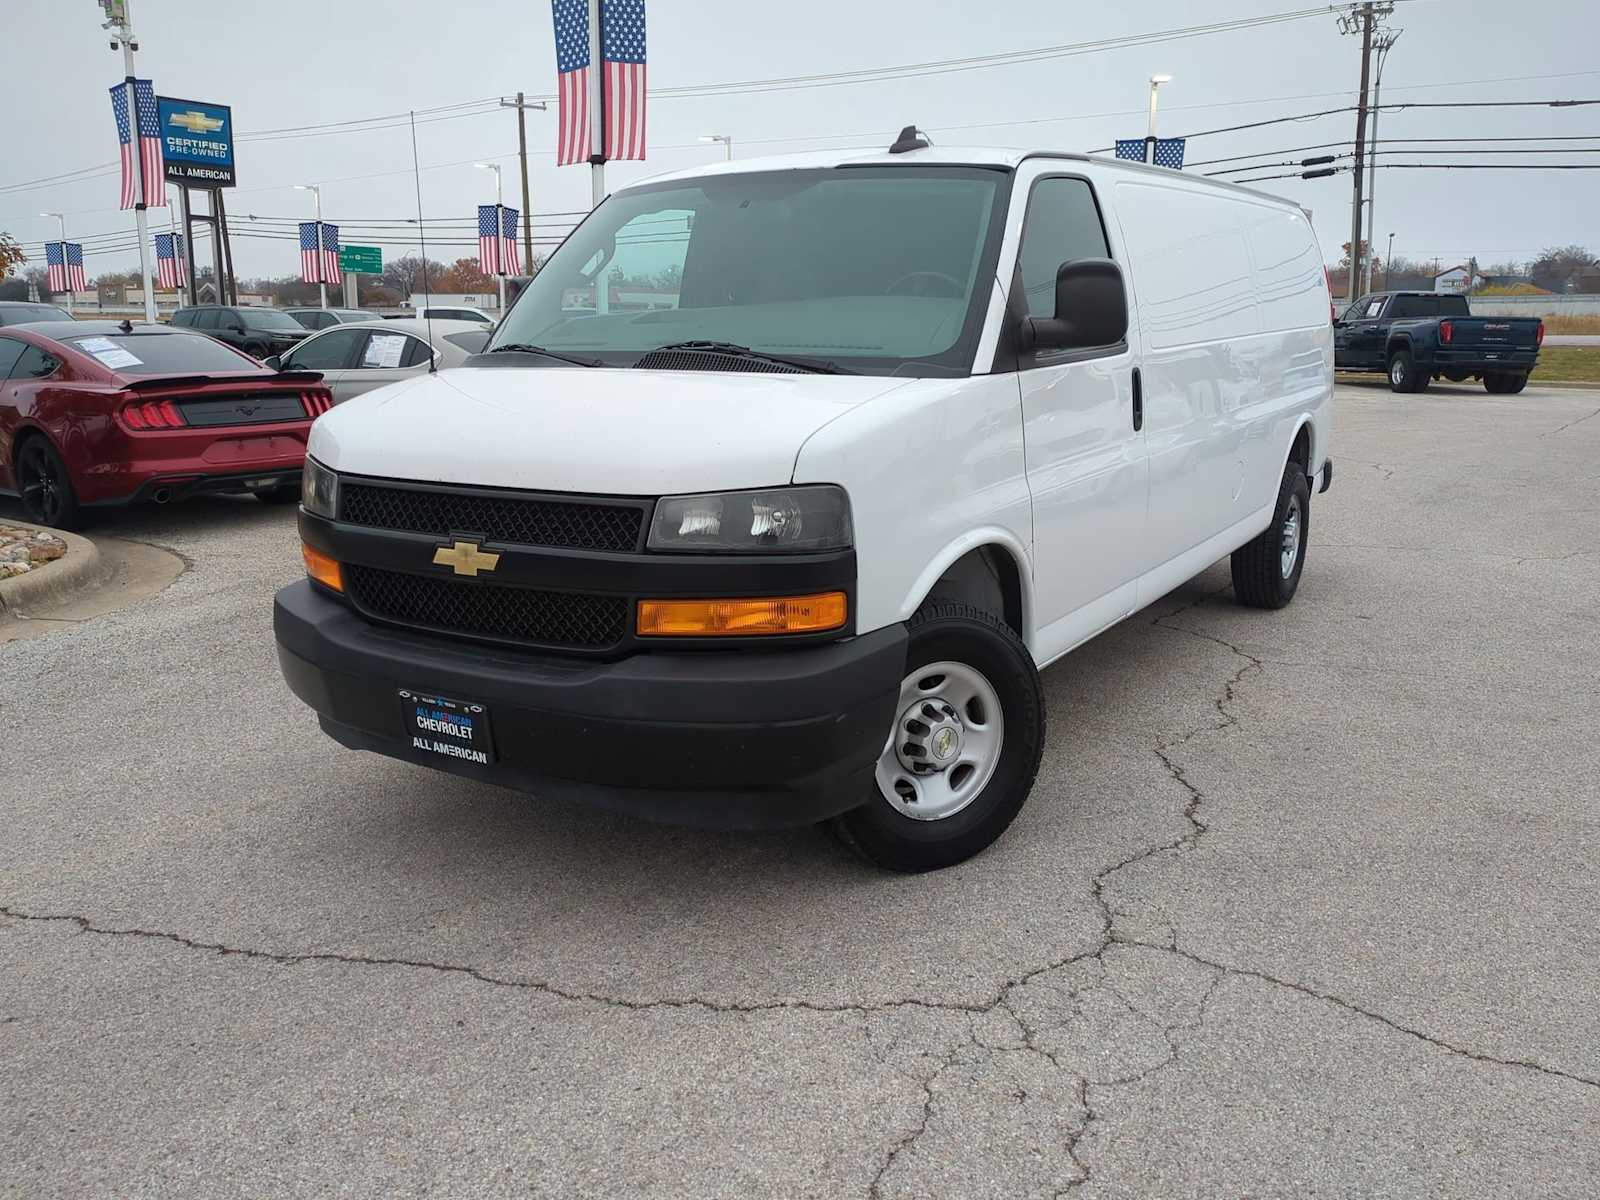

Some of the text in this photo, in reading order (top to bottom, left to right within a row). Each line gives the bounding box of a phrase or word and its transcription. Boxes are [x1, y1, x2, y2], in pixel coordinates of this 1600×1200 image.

[167, 136, 228, 151] CERTIFIED
[169, 145, 226, 158] PRE-OWNED
[168, 166, 231, 180] ALL AMERICAN
[416, 706, 472, 726] ALL AMERICAN
[416, 716, 473, 740] CHEVROLET
[413, 737, 487, 764] ALL AMERICAN
